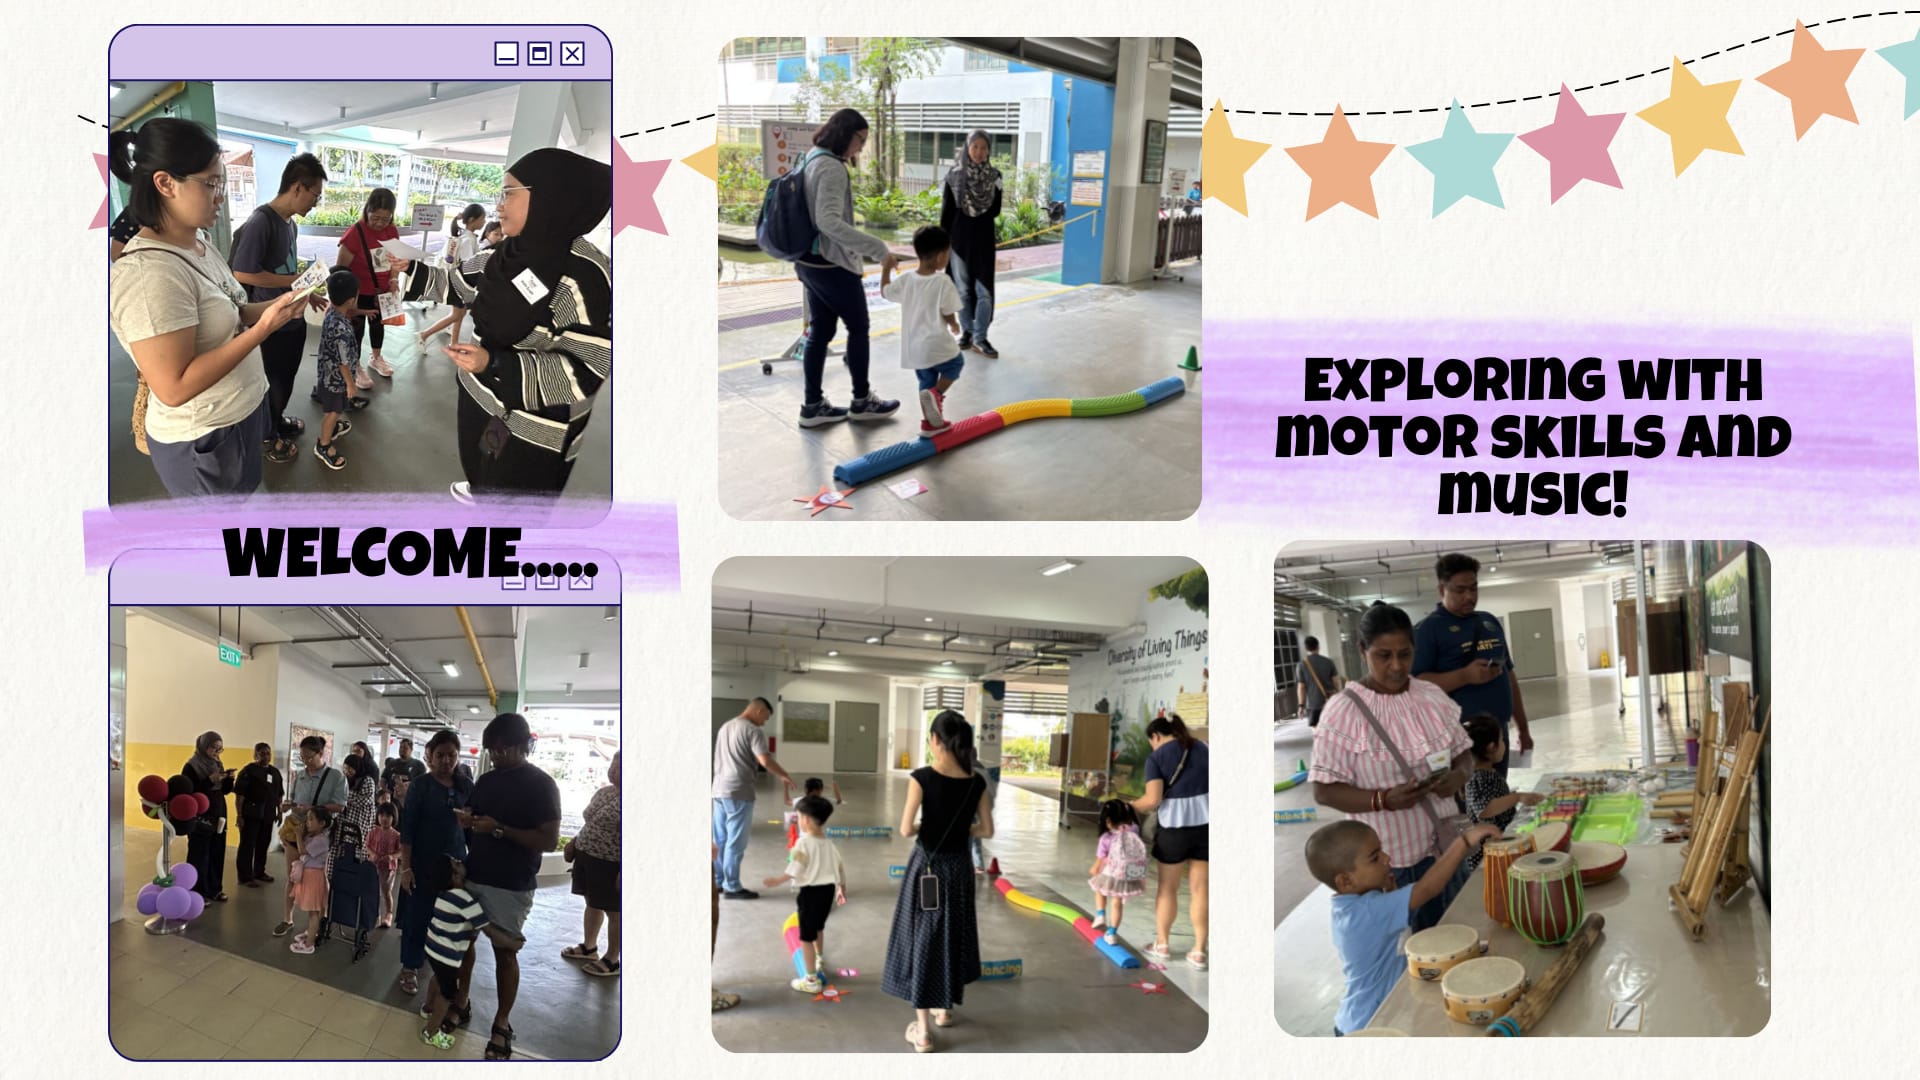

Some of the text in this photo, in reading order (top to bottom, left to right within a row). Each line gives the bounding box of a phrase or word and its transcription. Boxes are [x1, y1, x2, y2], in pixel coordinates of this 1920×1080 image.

[220, 647, 236, 664] EXIT
[1137, 640, 1148, 659] of
[1147, 637, 1172, 657] Living
[1175, 629, 1208, 651] Things
